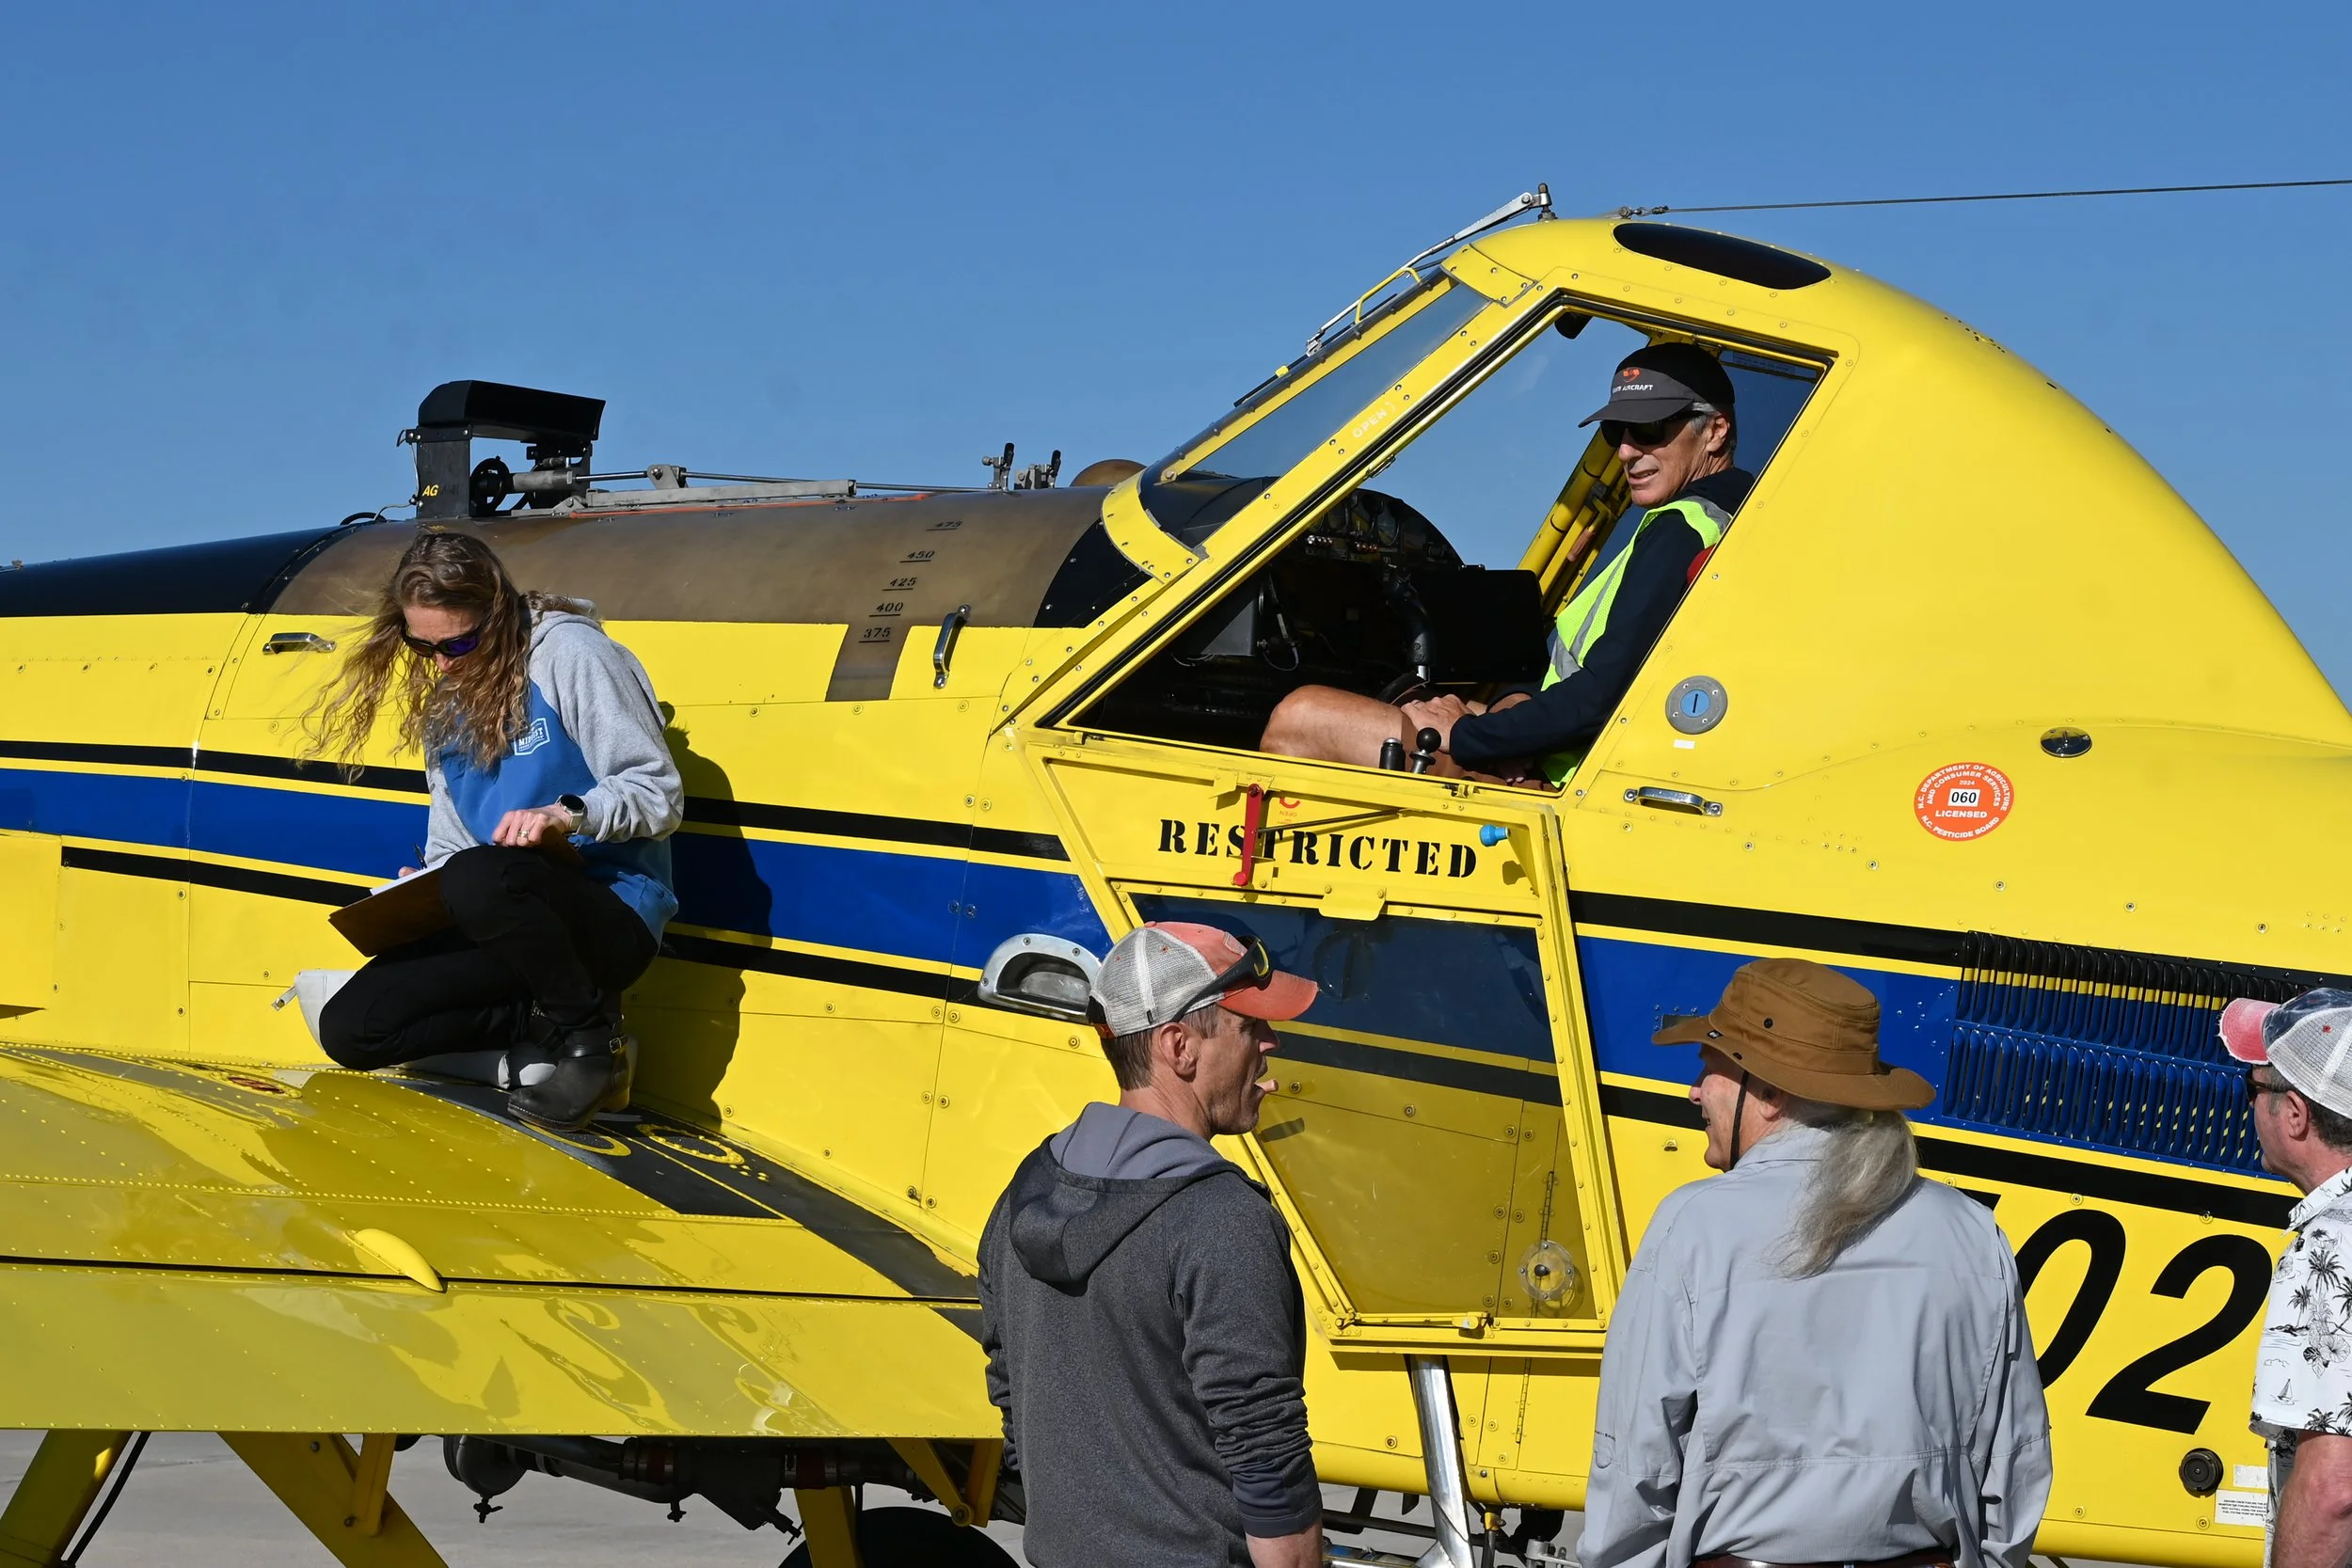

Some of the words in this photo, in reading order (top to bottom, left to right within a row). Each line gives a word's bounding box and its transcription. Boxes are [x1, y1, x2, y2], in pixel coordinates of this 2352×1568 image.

[1352, 408, 1388, 438] OPEN
[422, 484, 439, 497] AG
[907, 550, 935, 559] 450
[889, 578, 917, 587] 425
[876, 602, 903, 612] 400
[864, 627, 891, 638] 375
[1920, 764, 1971, 793] DEPARTMENT
[1985, 768, 2010, 812] AGRICULTURE
[1927, 789, 1936, 804] AND
[1933, 770, 1982, 788] CONSUMER
[1982, 775, 2001, 807] SERVICES
[1951, 791, 1977, 803] 060
[1934, 810, 1988, 818] LICENSED
[1921, 815, 1933, 829] N.C.
[1932, 826, 1975, 838] PESTICIDE
[1975, 816, 2000, 835] BOARD
[1157, 818, 1477, 879] RESTRICTED
[1957, 1187, 2273, 1435] 02
